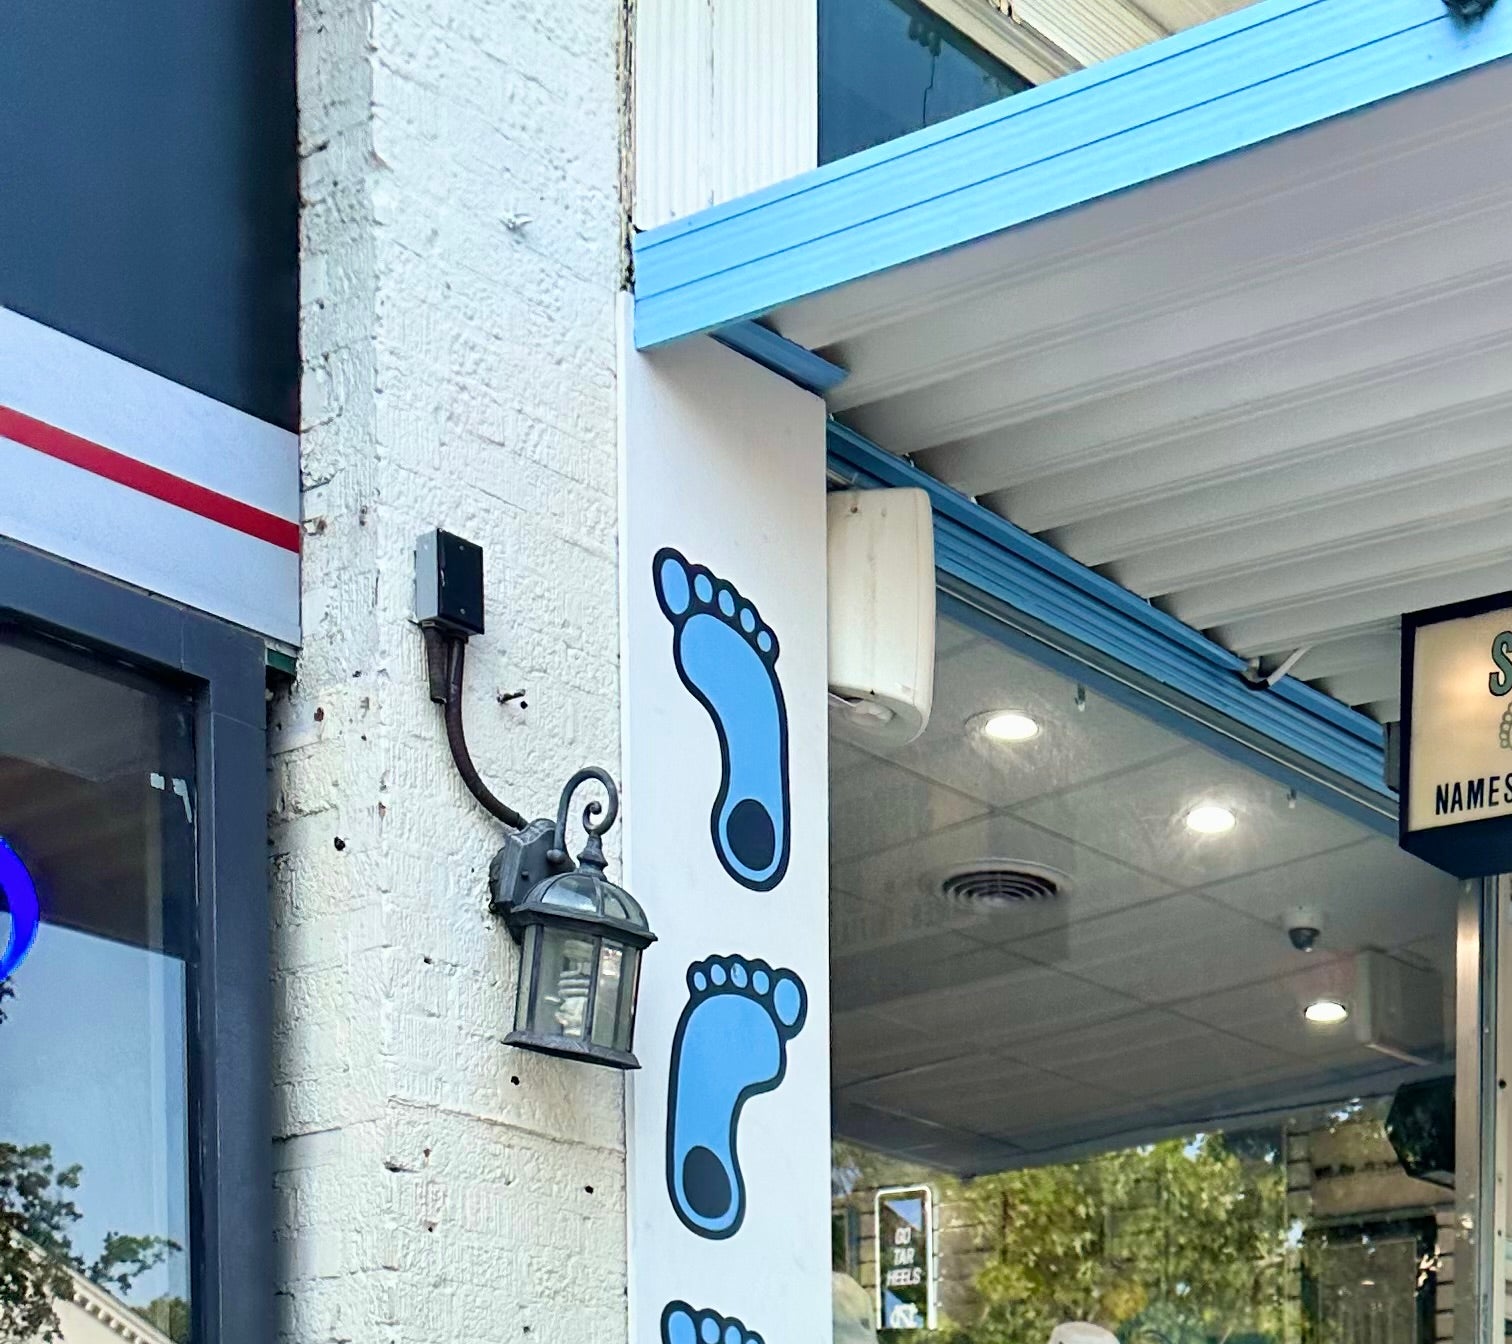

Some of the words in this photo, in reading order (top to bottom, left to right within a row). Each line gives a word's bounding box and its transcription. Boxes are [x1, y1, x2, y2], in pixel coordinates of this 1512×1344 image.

[894, 1227, 912, 1245] GO
[894, 1247, 915, 1265] TAR
[886, 1267, 922, 1287] HEELS
